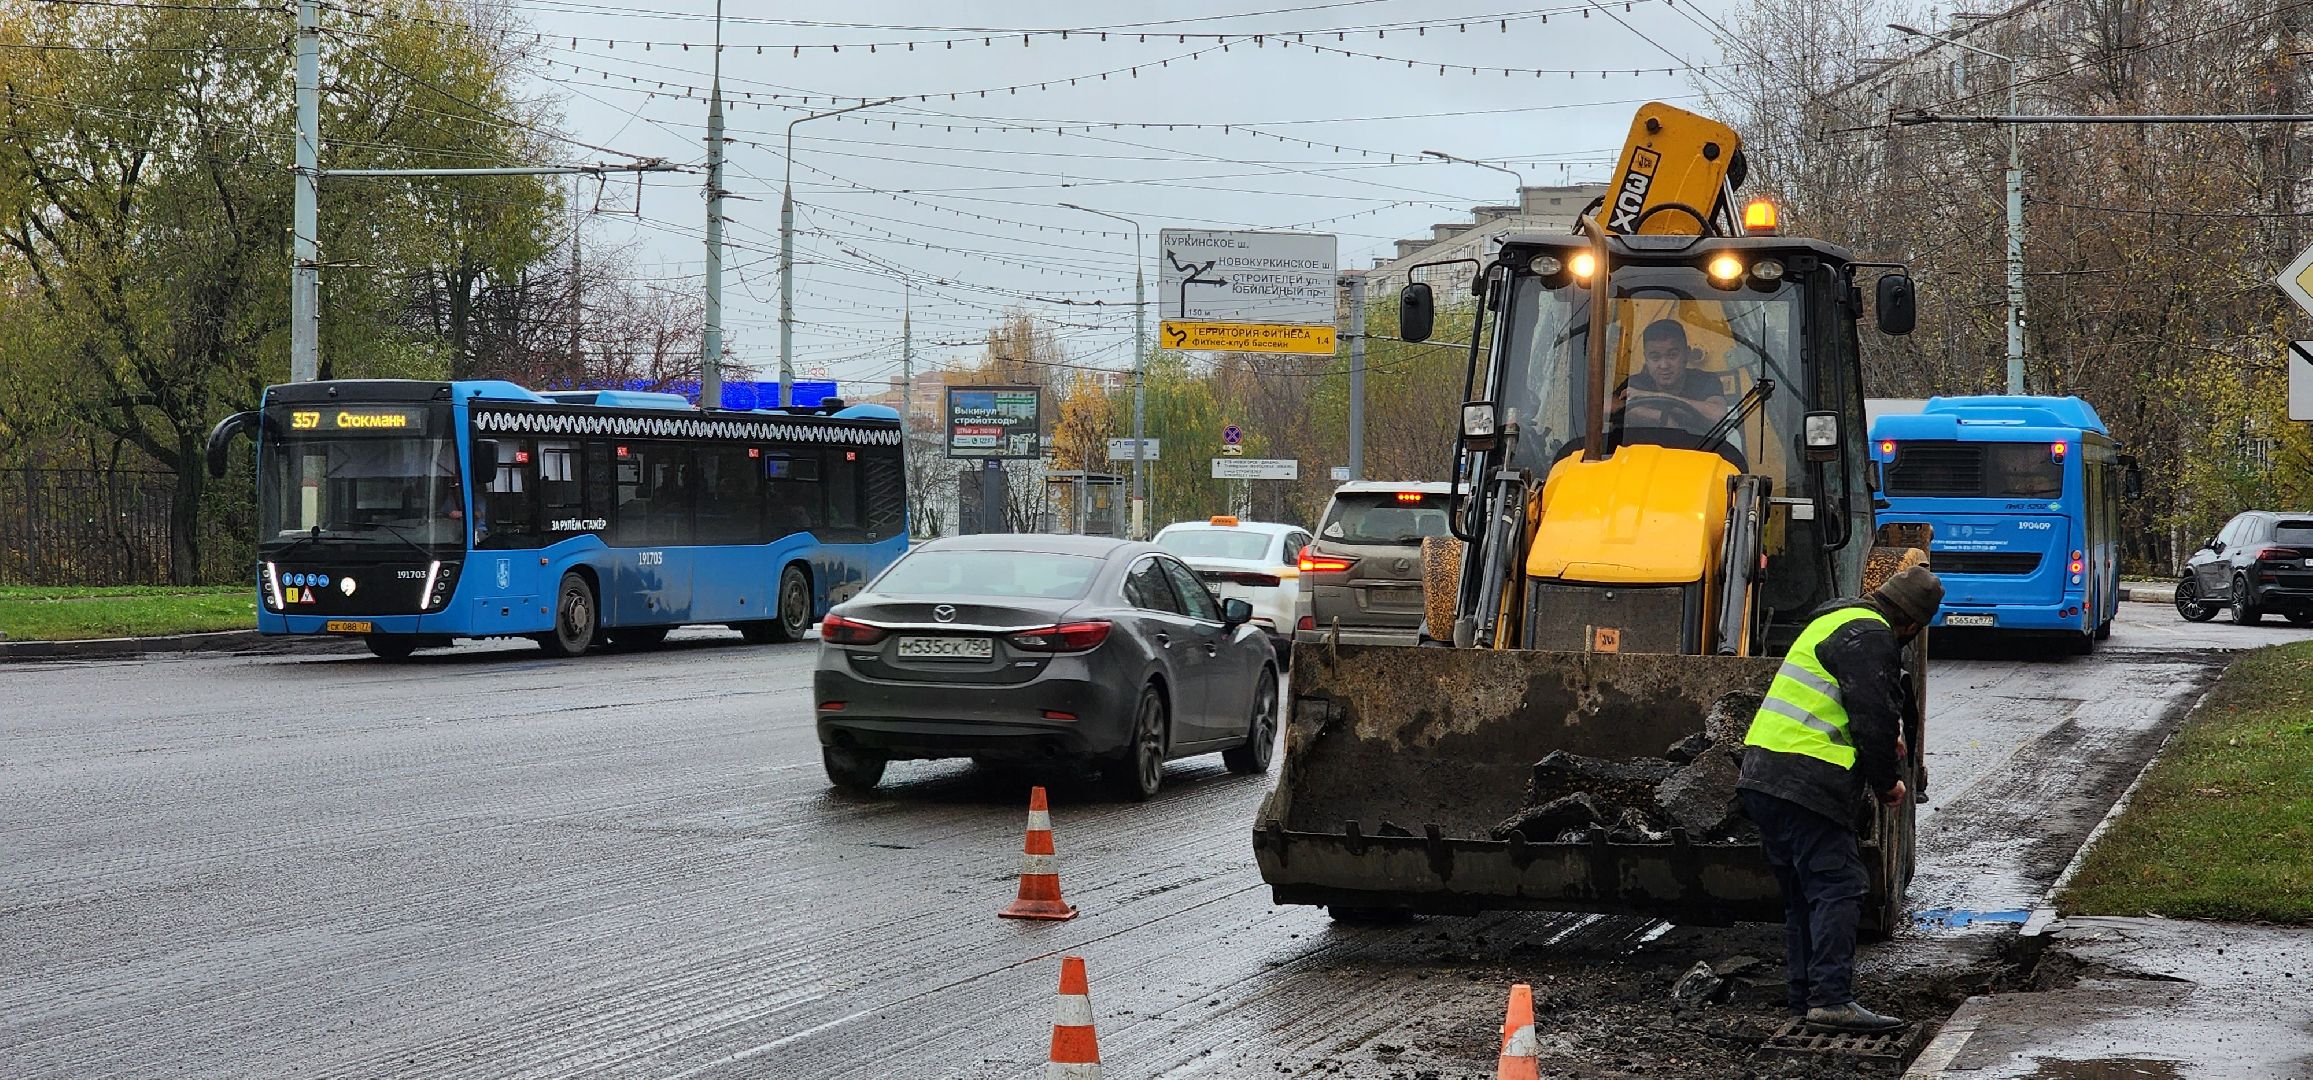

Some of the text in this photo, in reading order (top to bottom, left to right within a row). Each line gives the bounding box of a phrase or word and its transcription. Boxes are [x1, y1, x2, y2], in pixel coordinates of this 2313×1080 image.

[1638, 154, 1653, 169] JCB
[1609, 173, 1649, 232] 3CX
[1164, 236, 1250, 249] КУРКИНСКОЕ ш.
[1218, 256, 1319, 269] НОВОКУРКИНСКОЕ
[1232, 273, 1321, 286] СТРОИТЕЛЕЙ ул.
[1231, 284, 1304, 296] ЮБИЛЕЙНЫЙ
[1193, 326, 1311, 339] ТЕРРИТОРИЯ ФИТНЕСА
[1252, 339, 1288, 348] бассейн
[1316, 336, 1330, 345] 1.4
[954, 406, 997, 416] Выкинул
[292, 411, 406, 428] 357 Стокманн
[552, 518, 606, 531] ЗА РУЛЁМ СТАЖЁР
[2018, 521, 2051, 530] 190409
[638, 552, 663, 565] 191703
[397, 571, 426, 579] 191703
[342, 622, 357, 630] 088
[360, 622, 369, 630] 77
